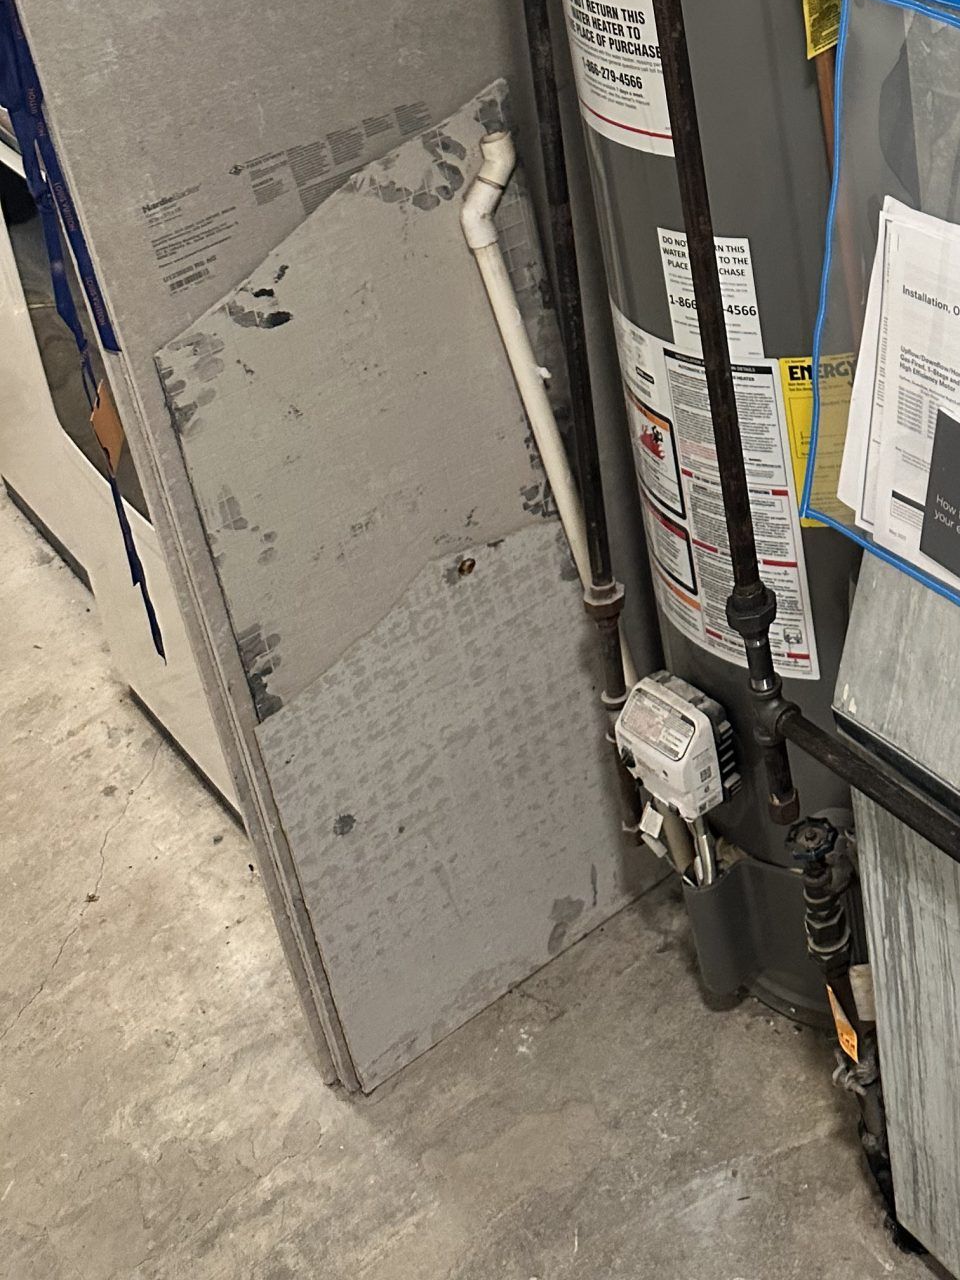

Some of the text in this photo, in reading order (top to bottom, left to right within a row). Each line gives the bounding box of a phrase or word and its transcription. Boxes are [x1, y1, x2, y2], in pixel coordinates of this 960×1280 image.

[571, 5, 641, 40] WATER HEATER TO
[586, 0, 619, 20] RETURN
[620, 8, 645, 25] THIS
[576, 23, 595, 44] PLACE
[596, 35, 606, 48] OF
[609, 38, 661, 59] PURCHASE
[662, 236, 673, 245] DO
[675, 238, 687, 247] NO
[726, 245, 745, 253] THIS
[662, 248, 686, 258] WATER
[733, 257, 748, 265] THE
[668, 259, 745, 277] PLACE CHASE
[902, 285, 951, 313] Installation,
[900, 361, 956, 393] High Efficiency Motor
[928, 364, 949, 381] 1-Stage
[950, 375, 960, 385] and
[936, 493, 956, 515] How
[934, 509, 954, 527] your
